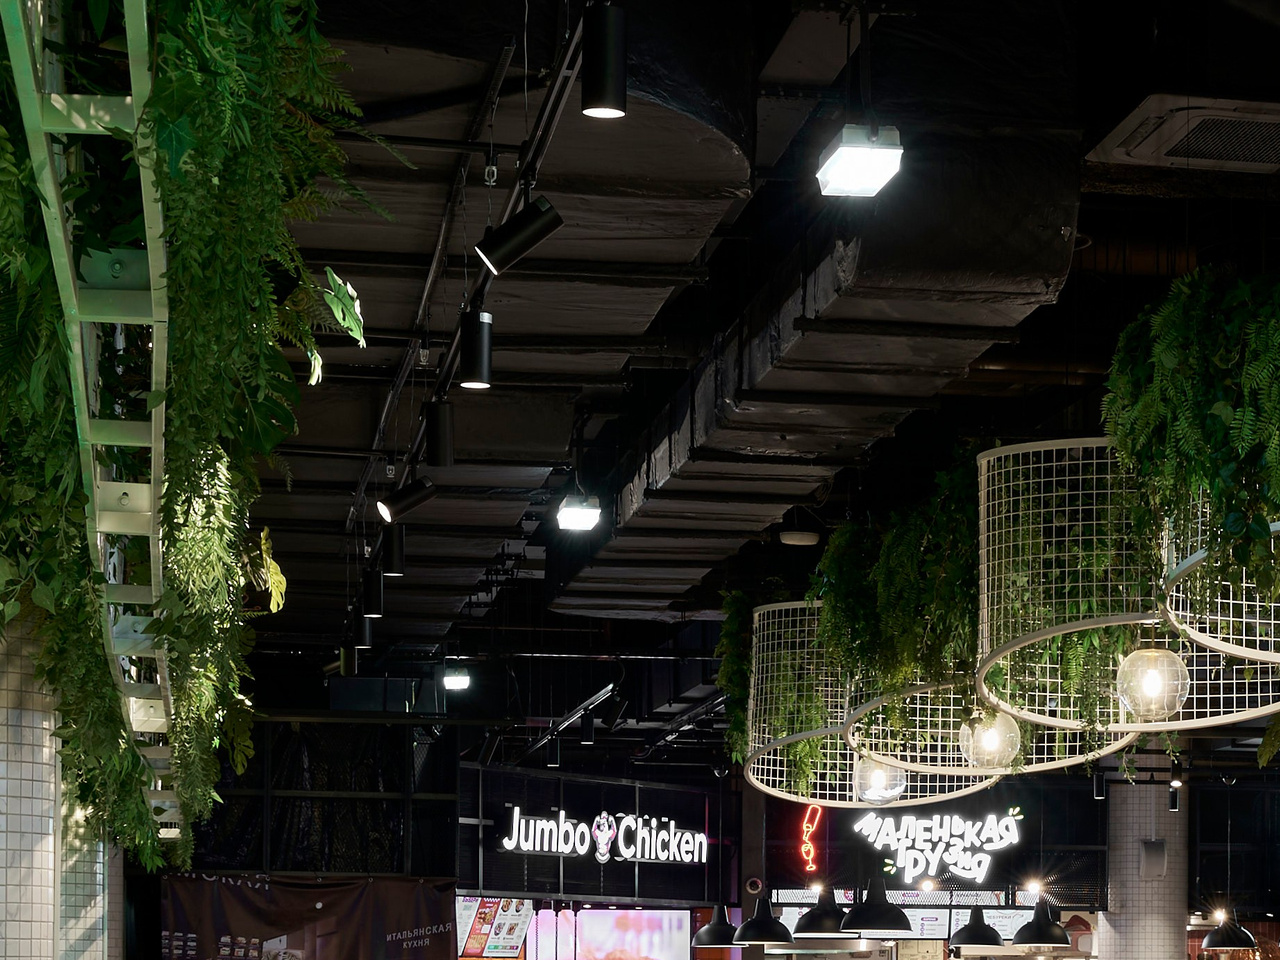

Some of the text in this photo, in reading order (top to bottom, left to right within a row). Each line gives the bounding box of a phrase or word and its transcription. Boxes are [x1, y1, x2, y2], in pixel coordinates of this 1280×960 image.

[502, 806, 708, 863] Jumbo Chicken
[854, 812, 1019, 851] МАЛЕНЬКАЯ
[896, 837, 991, 884] ГРУЗИЯ
[386, 922, 452, 942] ИТАЛЬЯНСКАЯ
[402, 938, 430, 949] КУХНЯ
